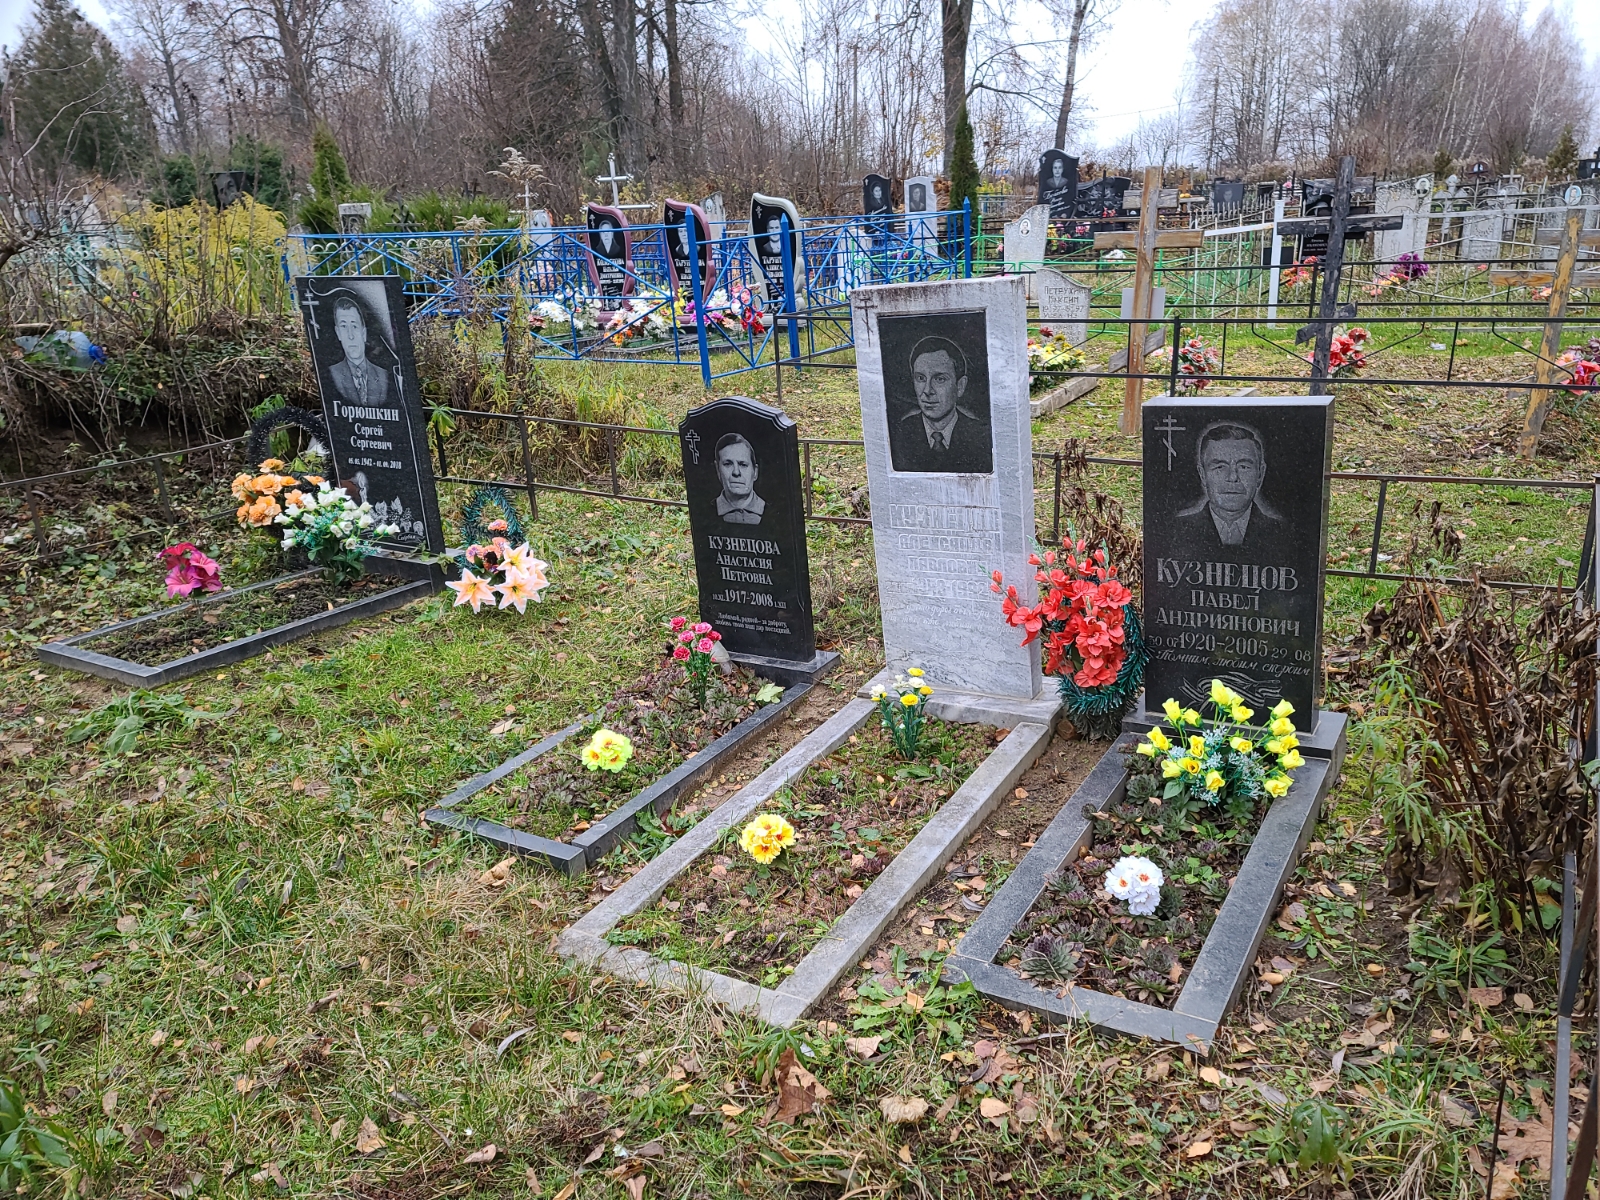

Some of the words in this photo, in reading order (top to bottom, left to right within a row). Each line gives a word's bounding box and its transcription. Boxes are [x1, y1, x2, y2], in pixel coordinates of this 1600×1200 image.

[332, 400, 400, 423] Горюшкин
[354, 422, 384, 438] Сергей
[350, 435, 393, 450] Сергеевич
[708, 535, 781, 556] КУЗНЕЦОВА
[1156, 557, 1299, 594] КУЗНЕЦОВ
[1190, 589, 1260, 611] ПАВЕЛ
[1155, 607, 1301, 637] АНДРИЯНОВИЧ
